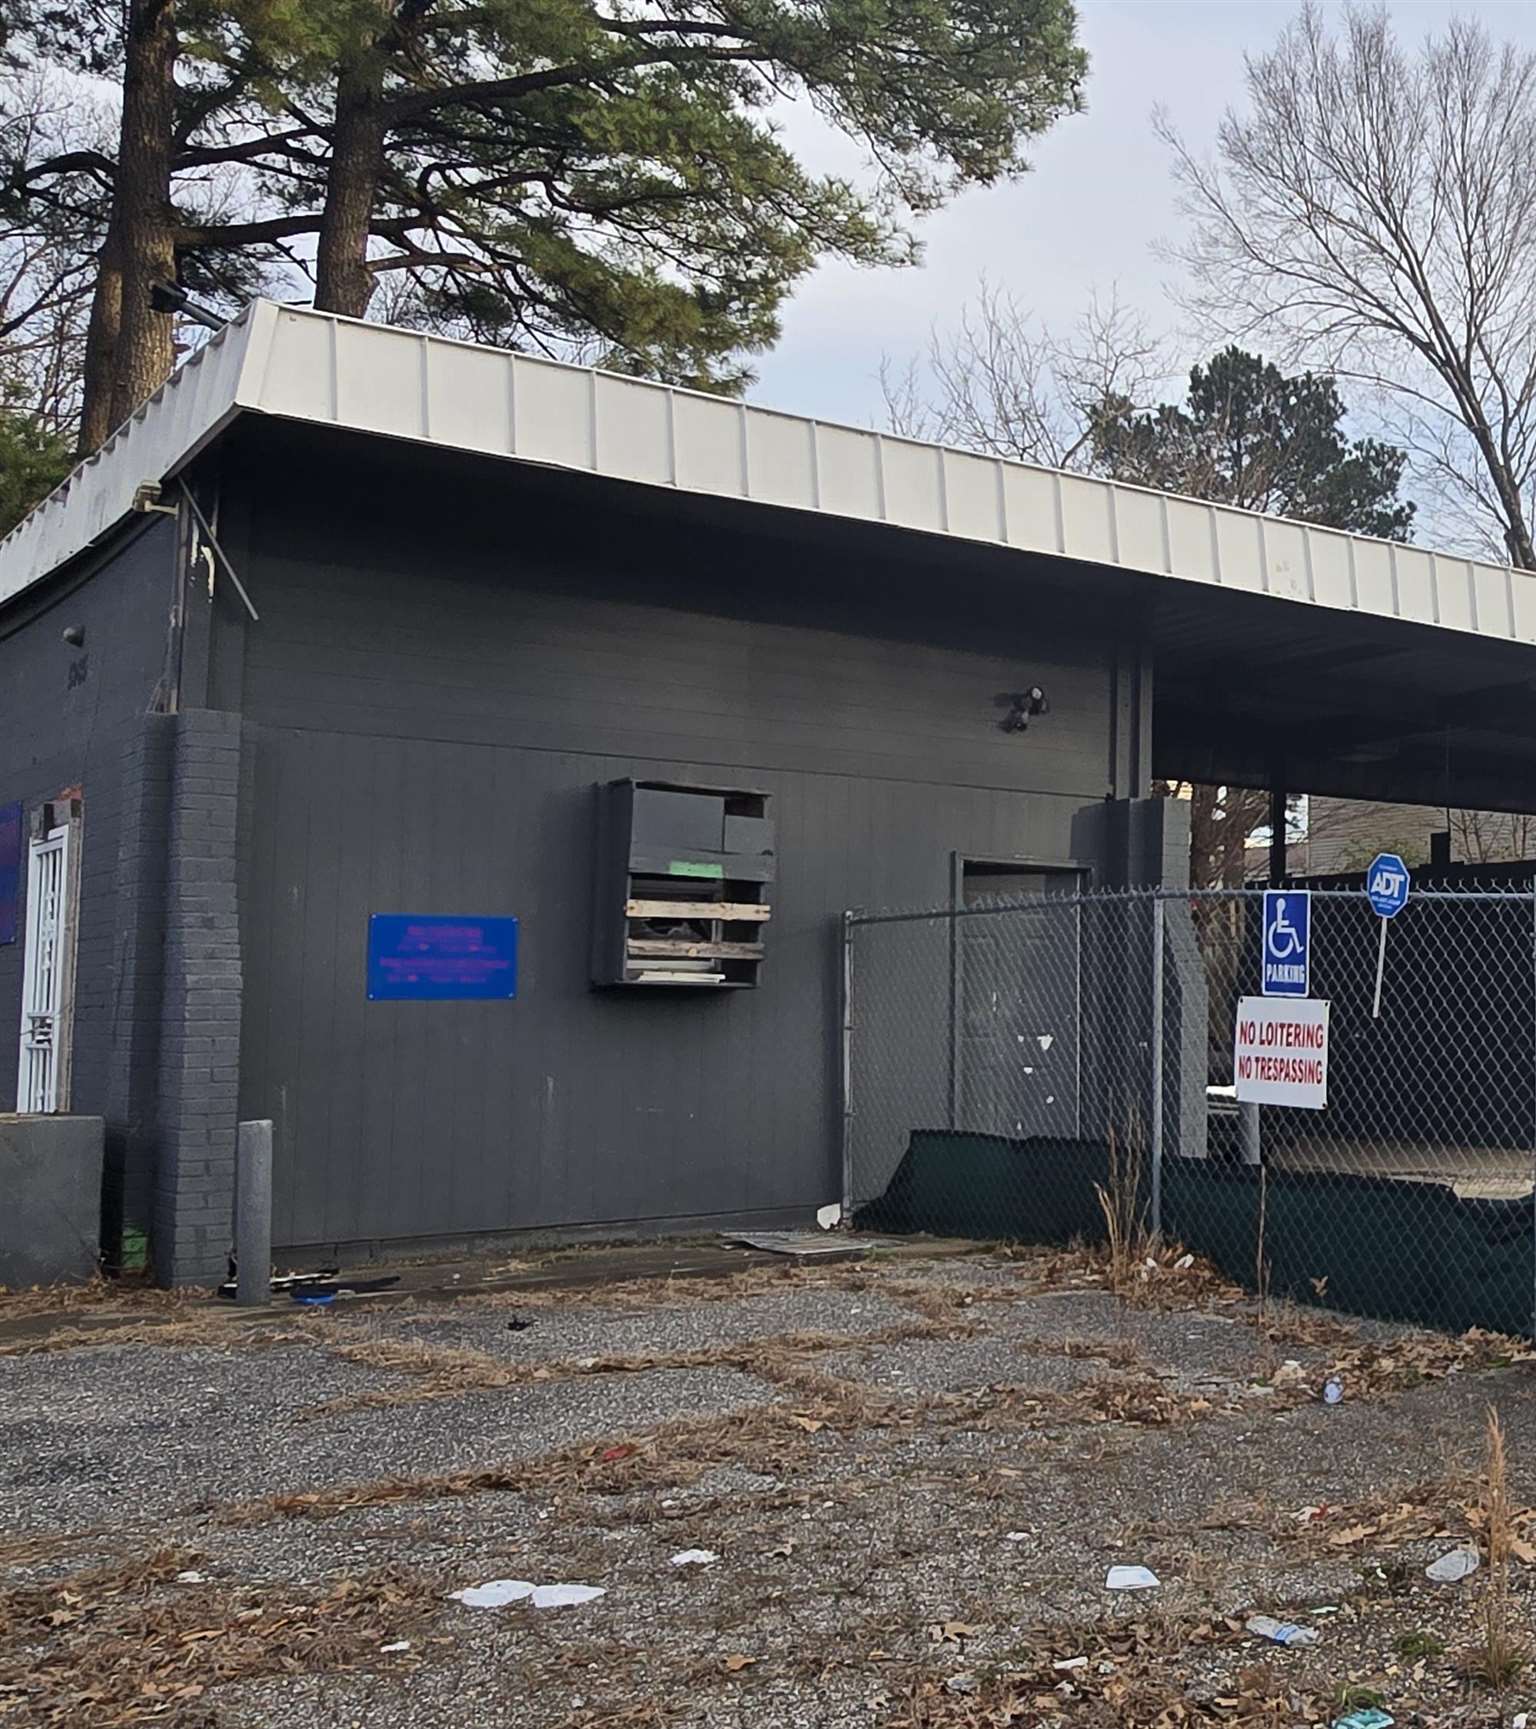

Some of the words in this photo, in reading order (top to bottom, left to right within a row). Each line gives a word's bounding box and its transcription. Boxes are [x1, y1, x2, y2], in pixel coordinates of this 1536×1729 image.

[1370, 871, 1405, 898] ADT
[1266, 964, 1305, 983] PARKING
[1239, 1021, 1256, 1045] NO
[1259, 1022, 1324, 1049] LOITERING
[1238, 1056, 1252, 1079] NO
[1255, 1056, 1323, 1084] TRESPASSING
